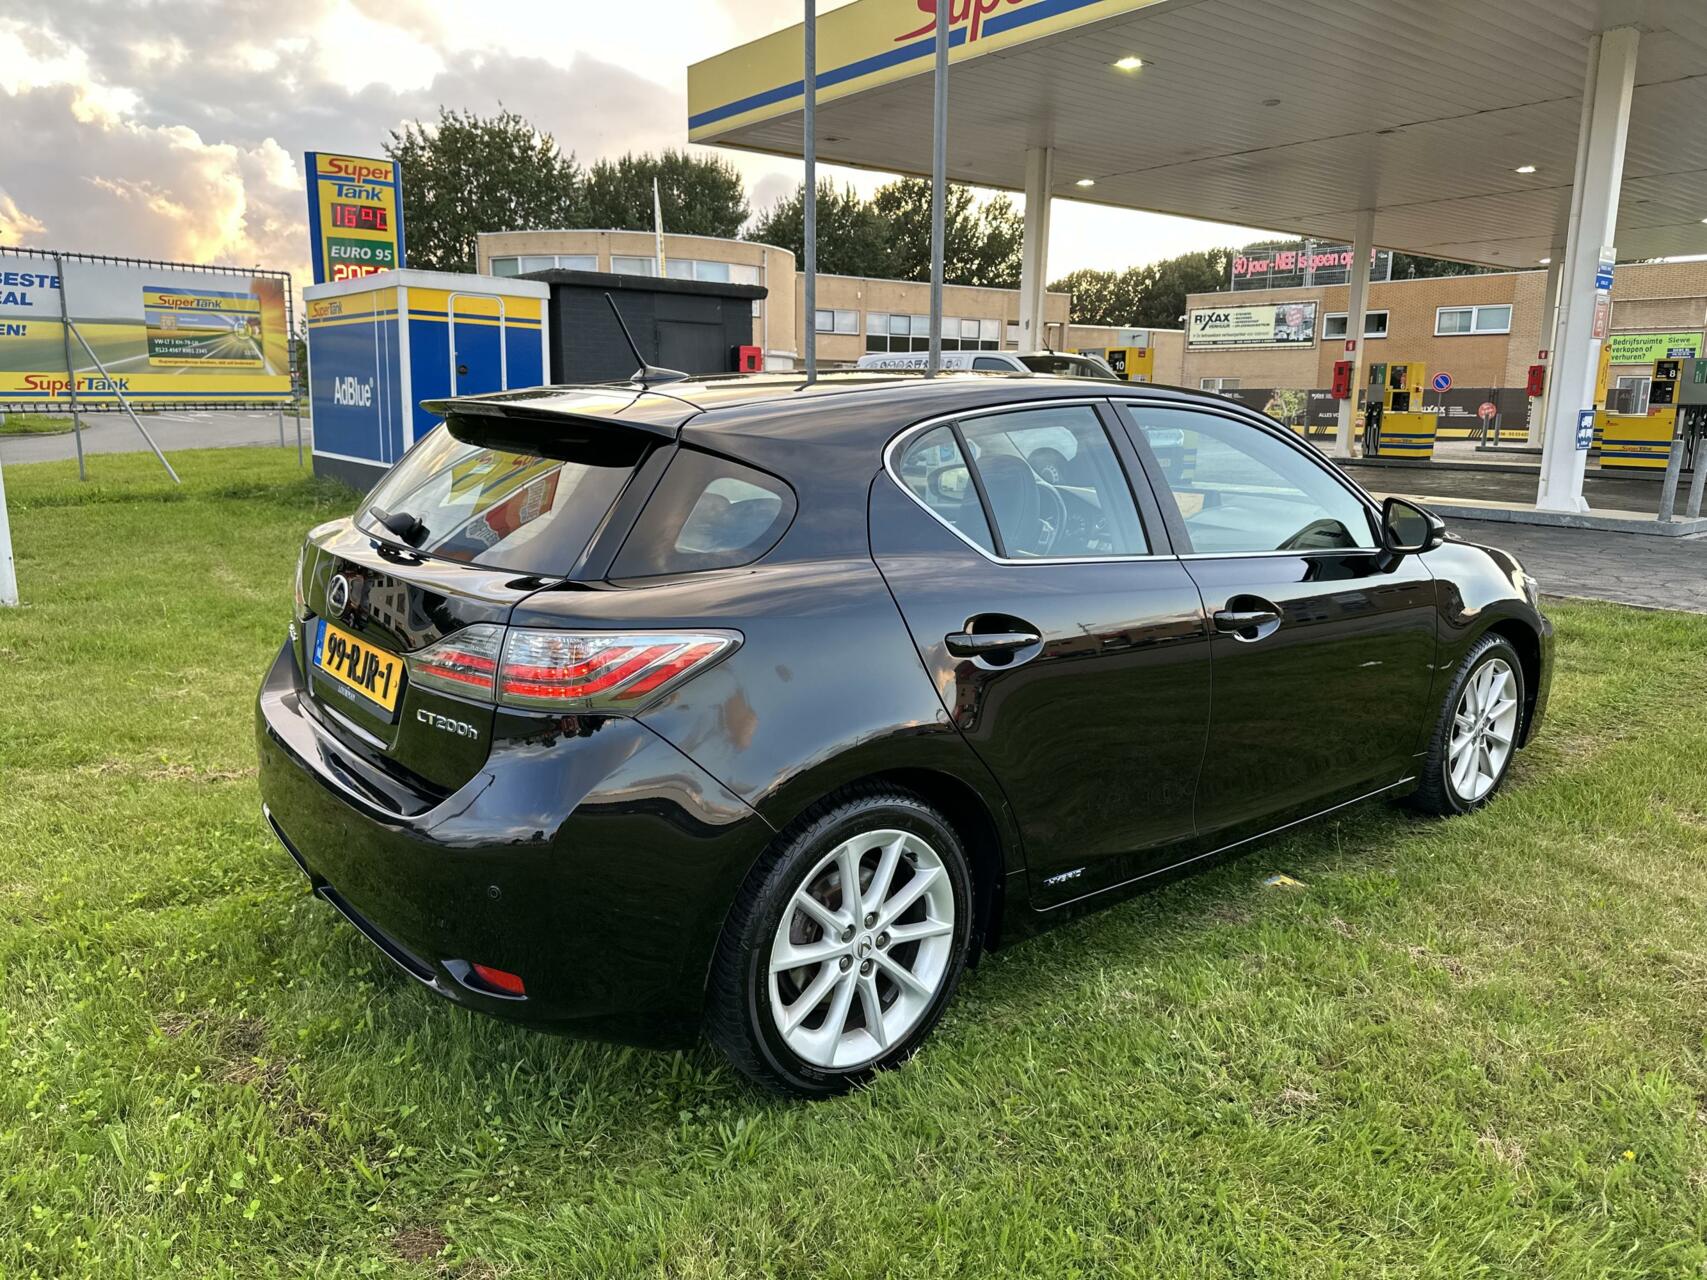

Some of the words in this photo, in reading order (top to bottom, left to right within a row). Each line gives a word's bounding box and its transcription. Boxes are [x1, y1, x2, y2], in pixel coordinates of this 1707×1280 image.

[319, 158, 392, 184] Super
[331, 182, 383, 202] Tank
[331, 245, 372, 259] EURO
[375, 249, 392, 261] 95
[1309, 252, 1338, 272] geen
[0, 272, 61, 289] ESTE
[0, 291, 33, 306] AL
[154, 294, 222, 310] SuperTank
[1611, 345, 1643, 354] verkopen
[1612, 337, 1663, 347] Bedrijfsruimte
[1610, 353, 1646, 361] verhuren?
[1115, 360, 1125, 371] 10
[1669, 369, 1676, 378] 8
[14, 374, 130, 397] SuperTank
[327, 632, 394, 700] 99-RJR-1
[416, 708, 478, 740] CT200h
